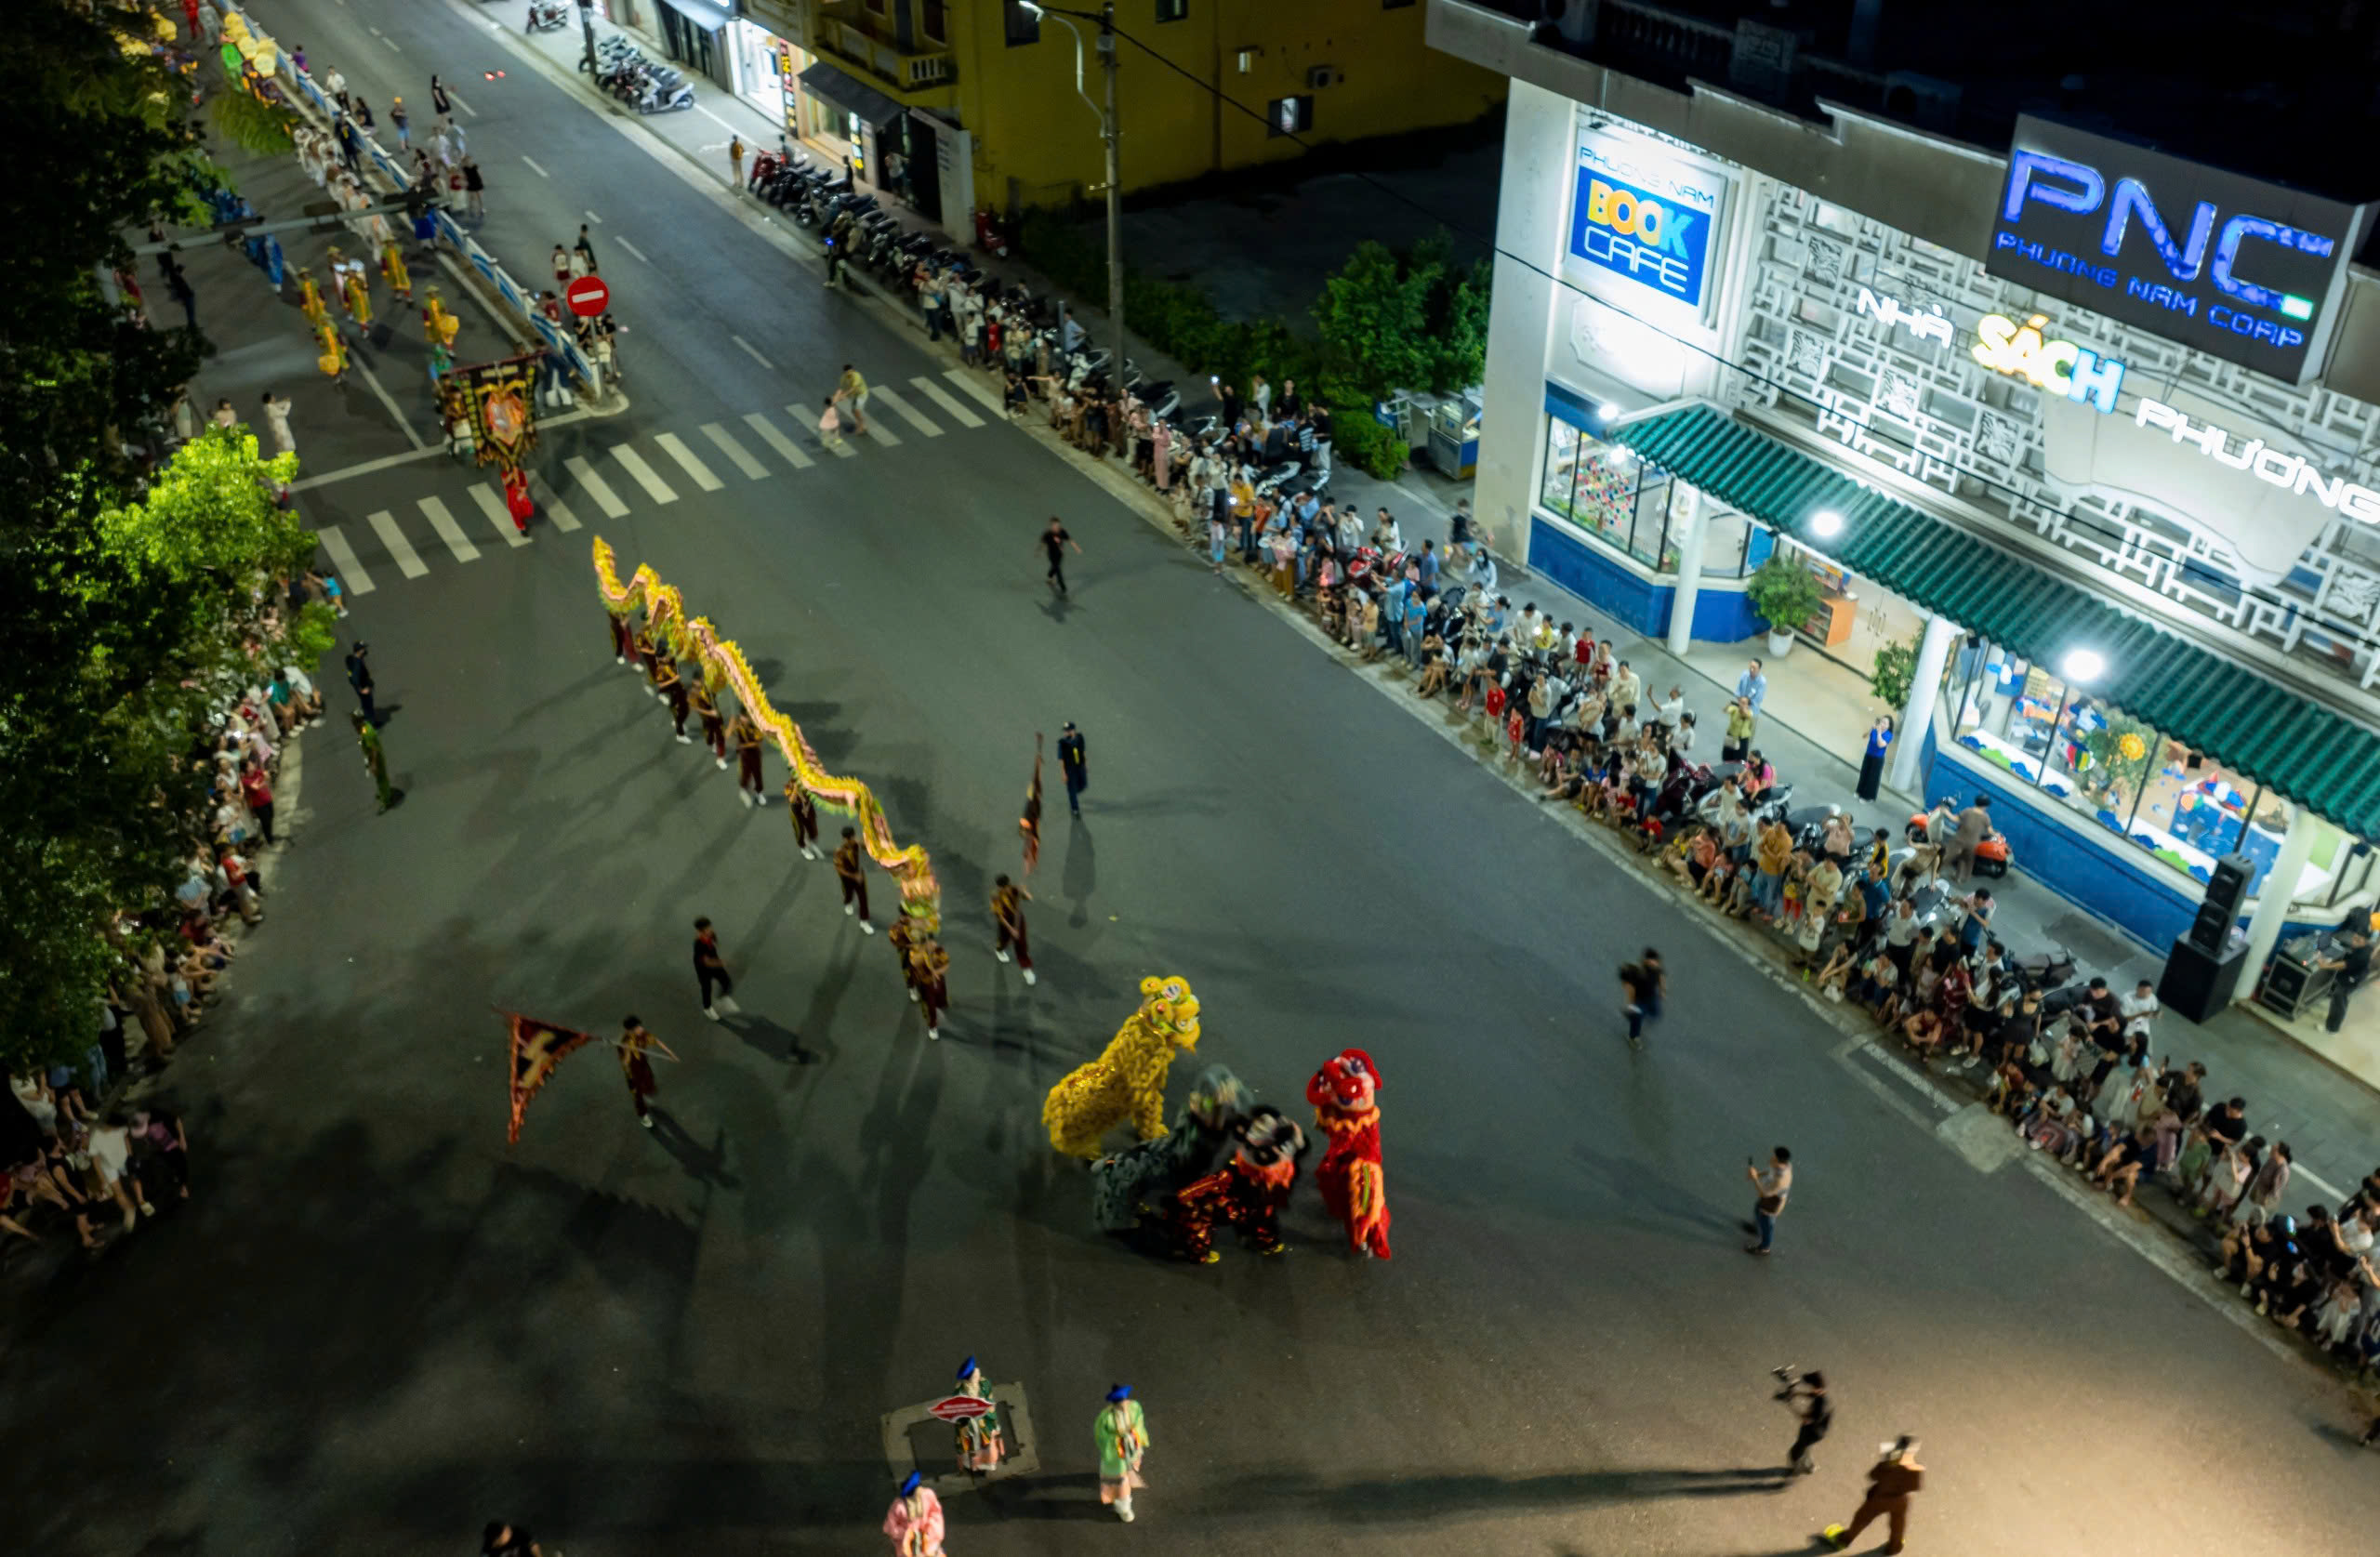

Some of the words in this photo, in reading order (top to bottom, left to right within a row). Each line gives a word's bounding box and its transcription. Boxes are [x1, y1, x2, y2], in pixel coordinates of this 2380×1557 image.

[1587, 178, 1694, 260] BOOK
[1668, 179, 1713, 209] NAM
[1584, 226, 1689, 293] CAFE
[2003, 149, 2335, 322] PNC
[2126, 276, 2199, 318] NAM
[1857, 287, 1953, 350] NHÀ
[1971, 313, 2125, 414] SÁCH
